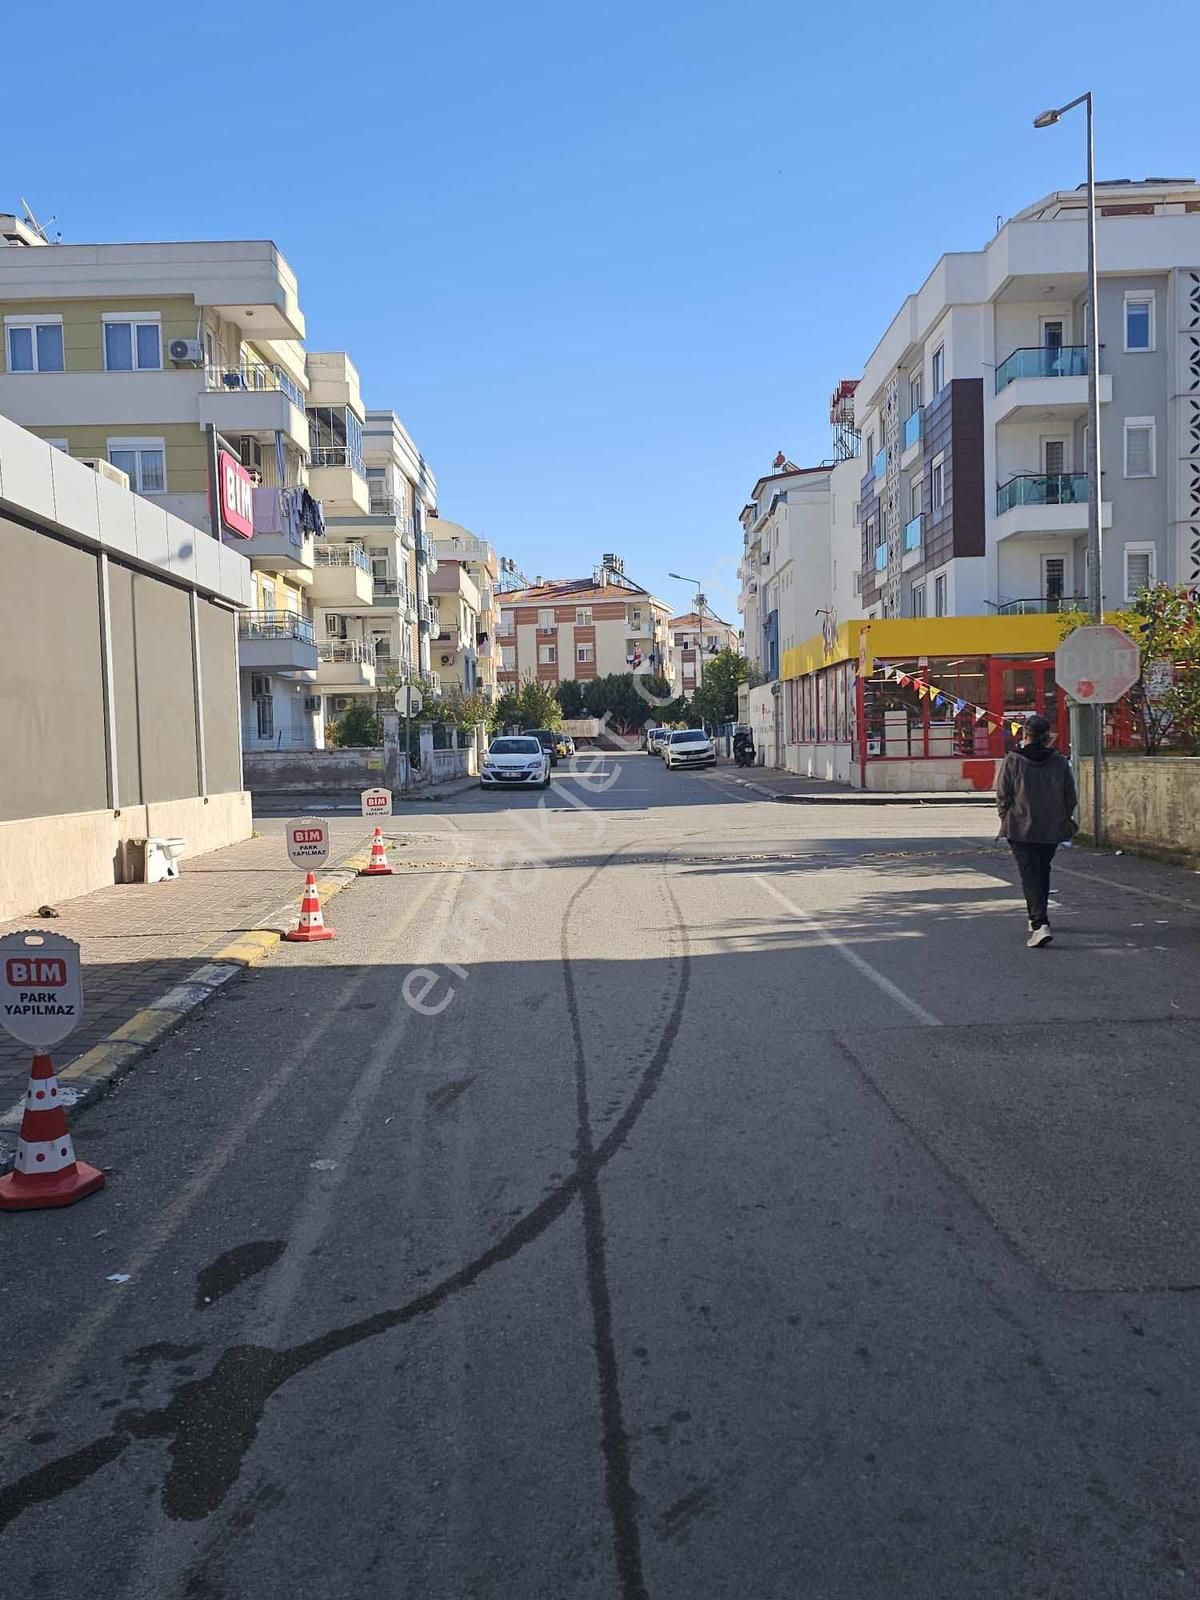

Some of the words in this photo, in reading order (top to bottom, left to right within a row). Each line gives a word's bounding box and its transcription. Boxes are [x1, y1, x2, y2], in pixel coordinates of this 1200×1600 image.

[1063, 648, 1131, 675] DUR
[20, 993, 57, 1002] PARK
[4, 1005, 75, 1015] YAPILMAZ
